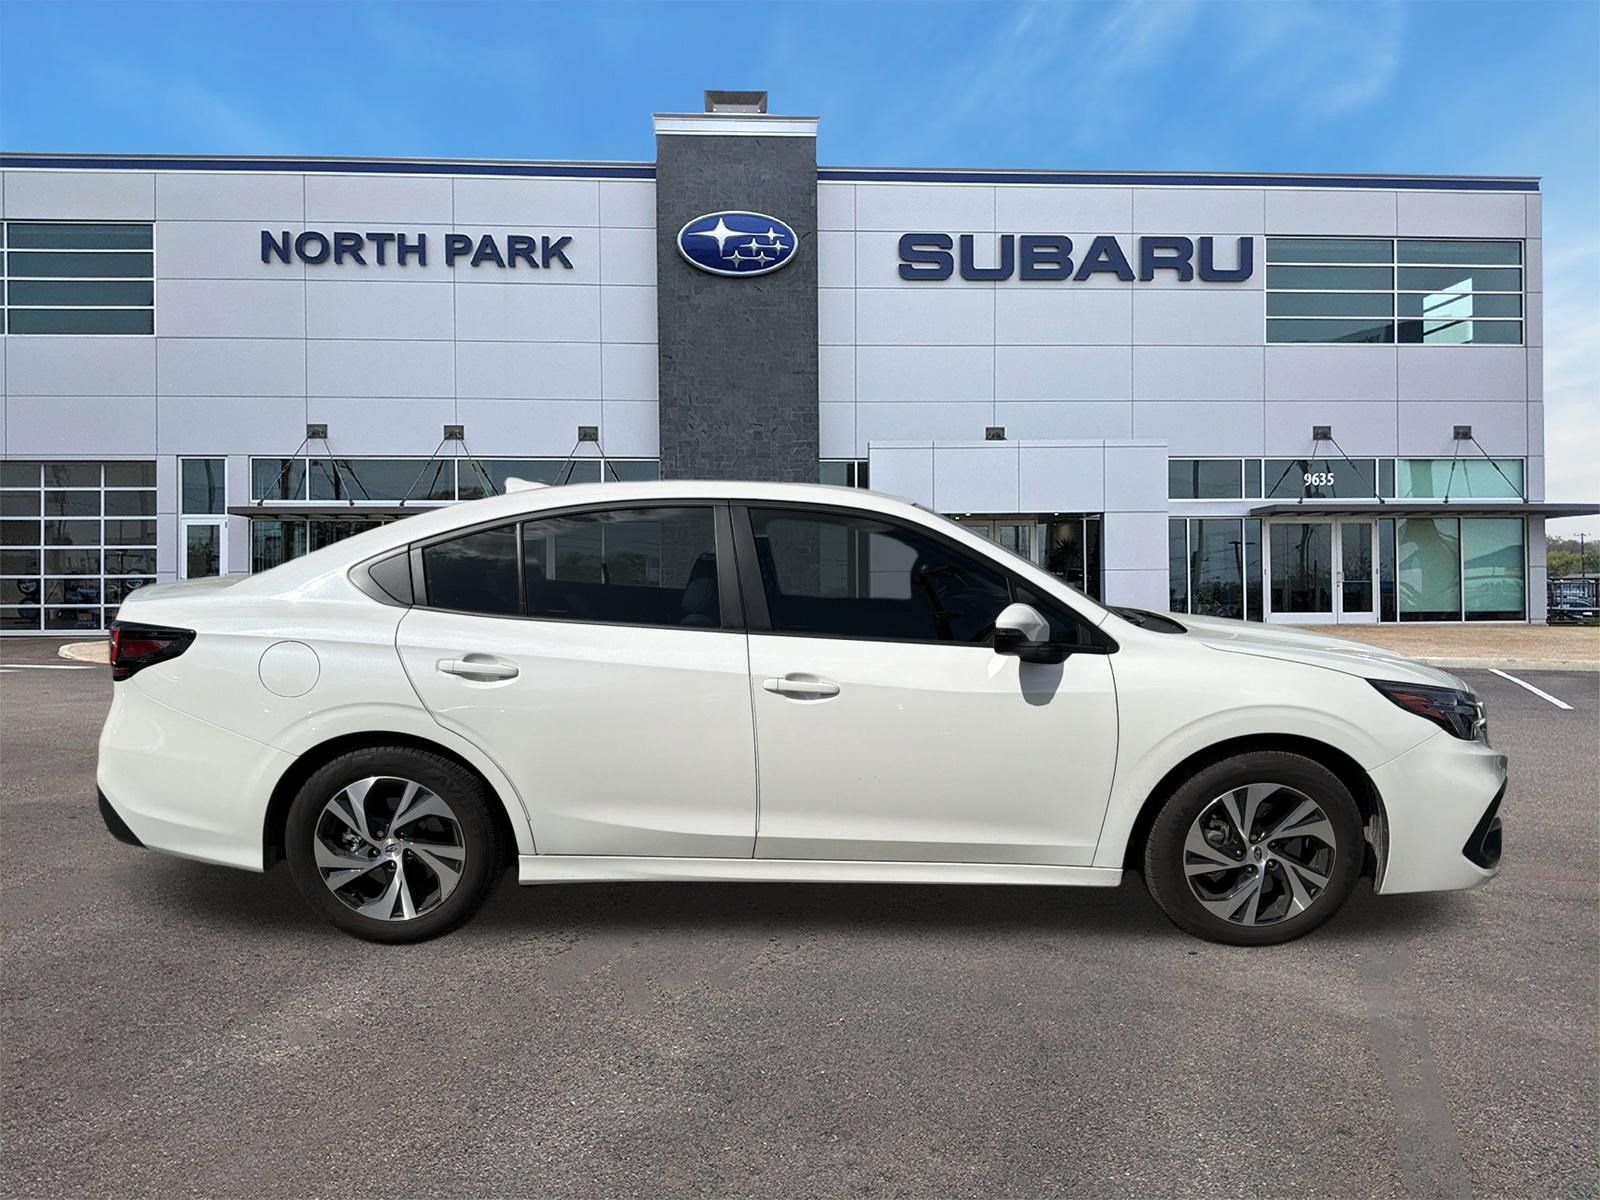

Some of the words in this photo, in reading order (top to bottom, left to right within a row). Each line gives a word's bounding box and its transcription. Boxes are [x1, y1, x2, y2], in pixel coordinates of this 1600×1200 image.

[260, 230, 428, 266] NORTH
[445, 233, 574, 269] PARK
[898, 233, 1254, 282] SUBARU
[1303, 472, 1335, 486] 9635
